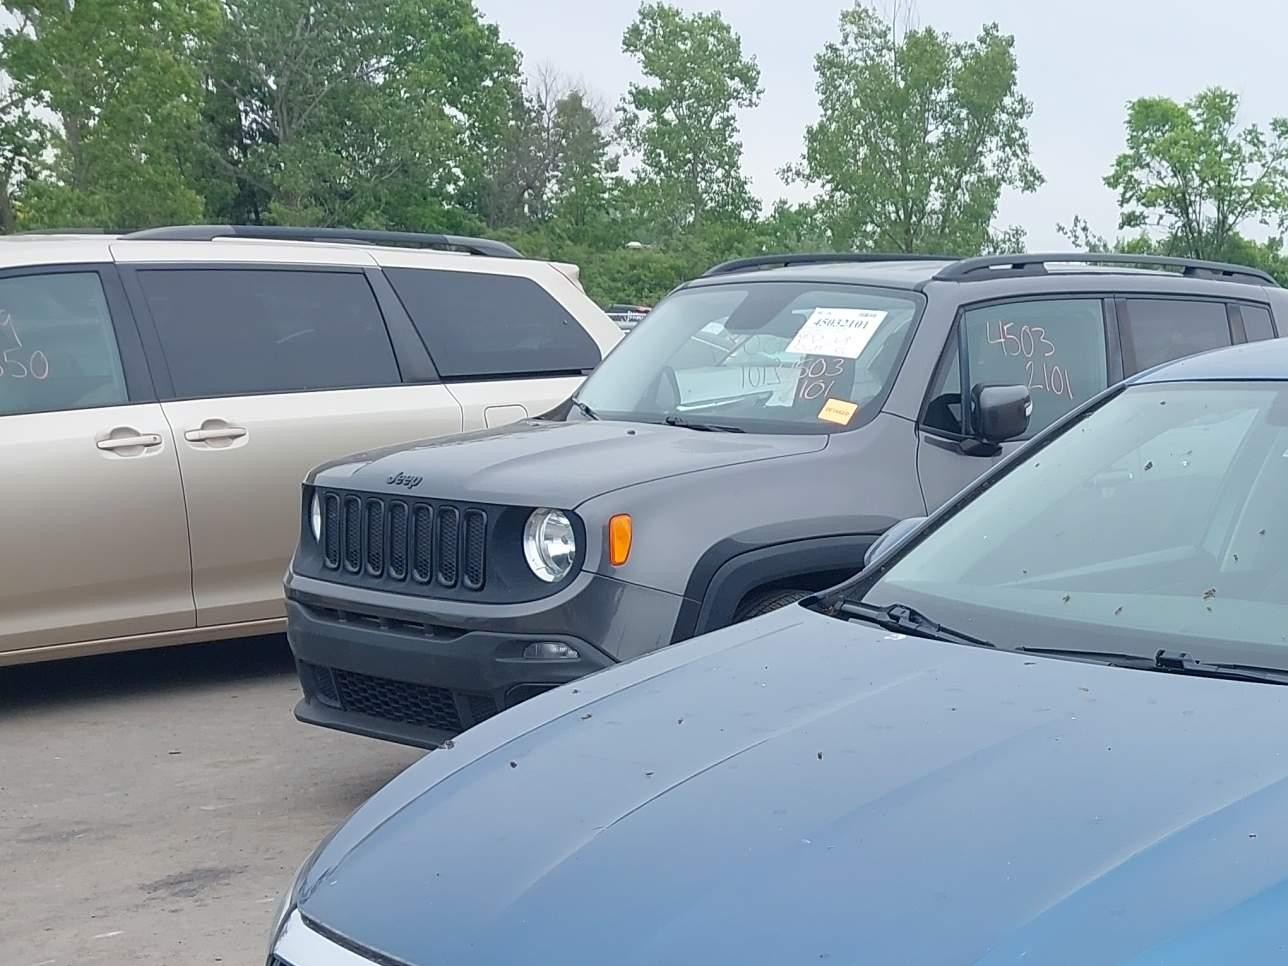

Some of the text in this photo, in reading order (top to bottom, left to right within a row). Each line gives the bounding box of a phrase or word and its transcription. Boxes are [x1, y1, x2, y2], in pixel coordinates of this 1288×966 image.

[986, 320, 1055, 357] 4503
[0, 350, 49, 379] 50
[1025, 360, 1073, 400] 2101
[386, 471, 424, 490] Jeep
